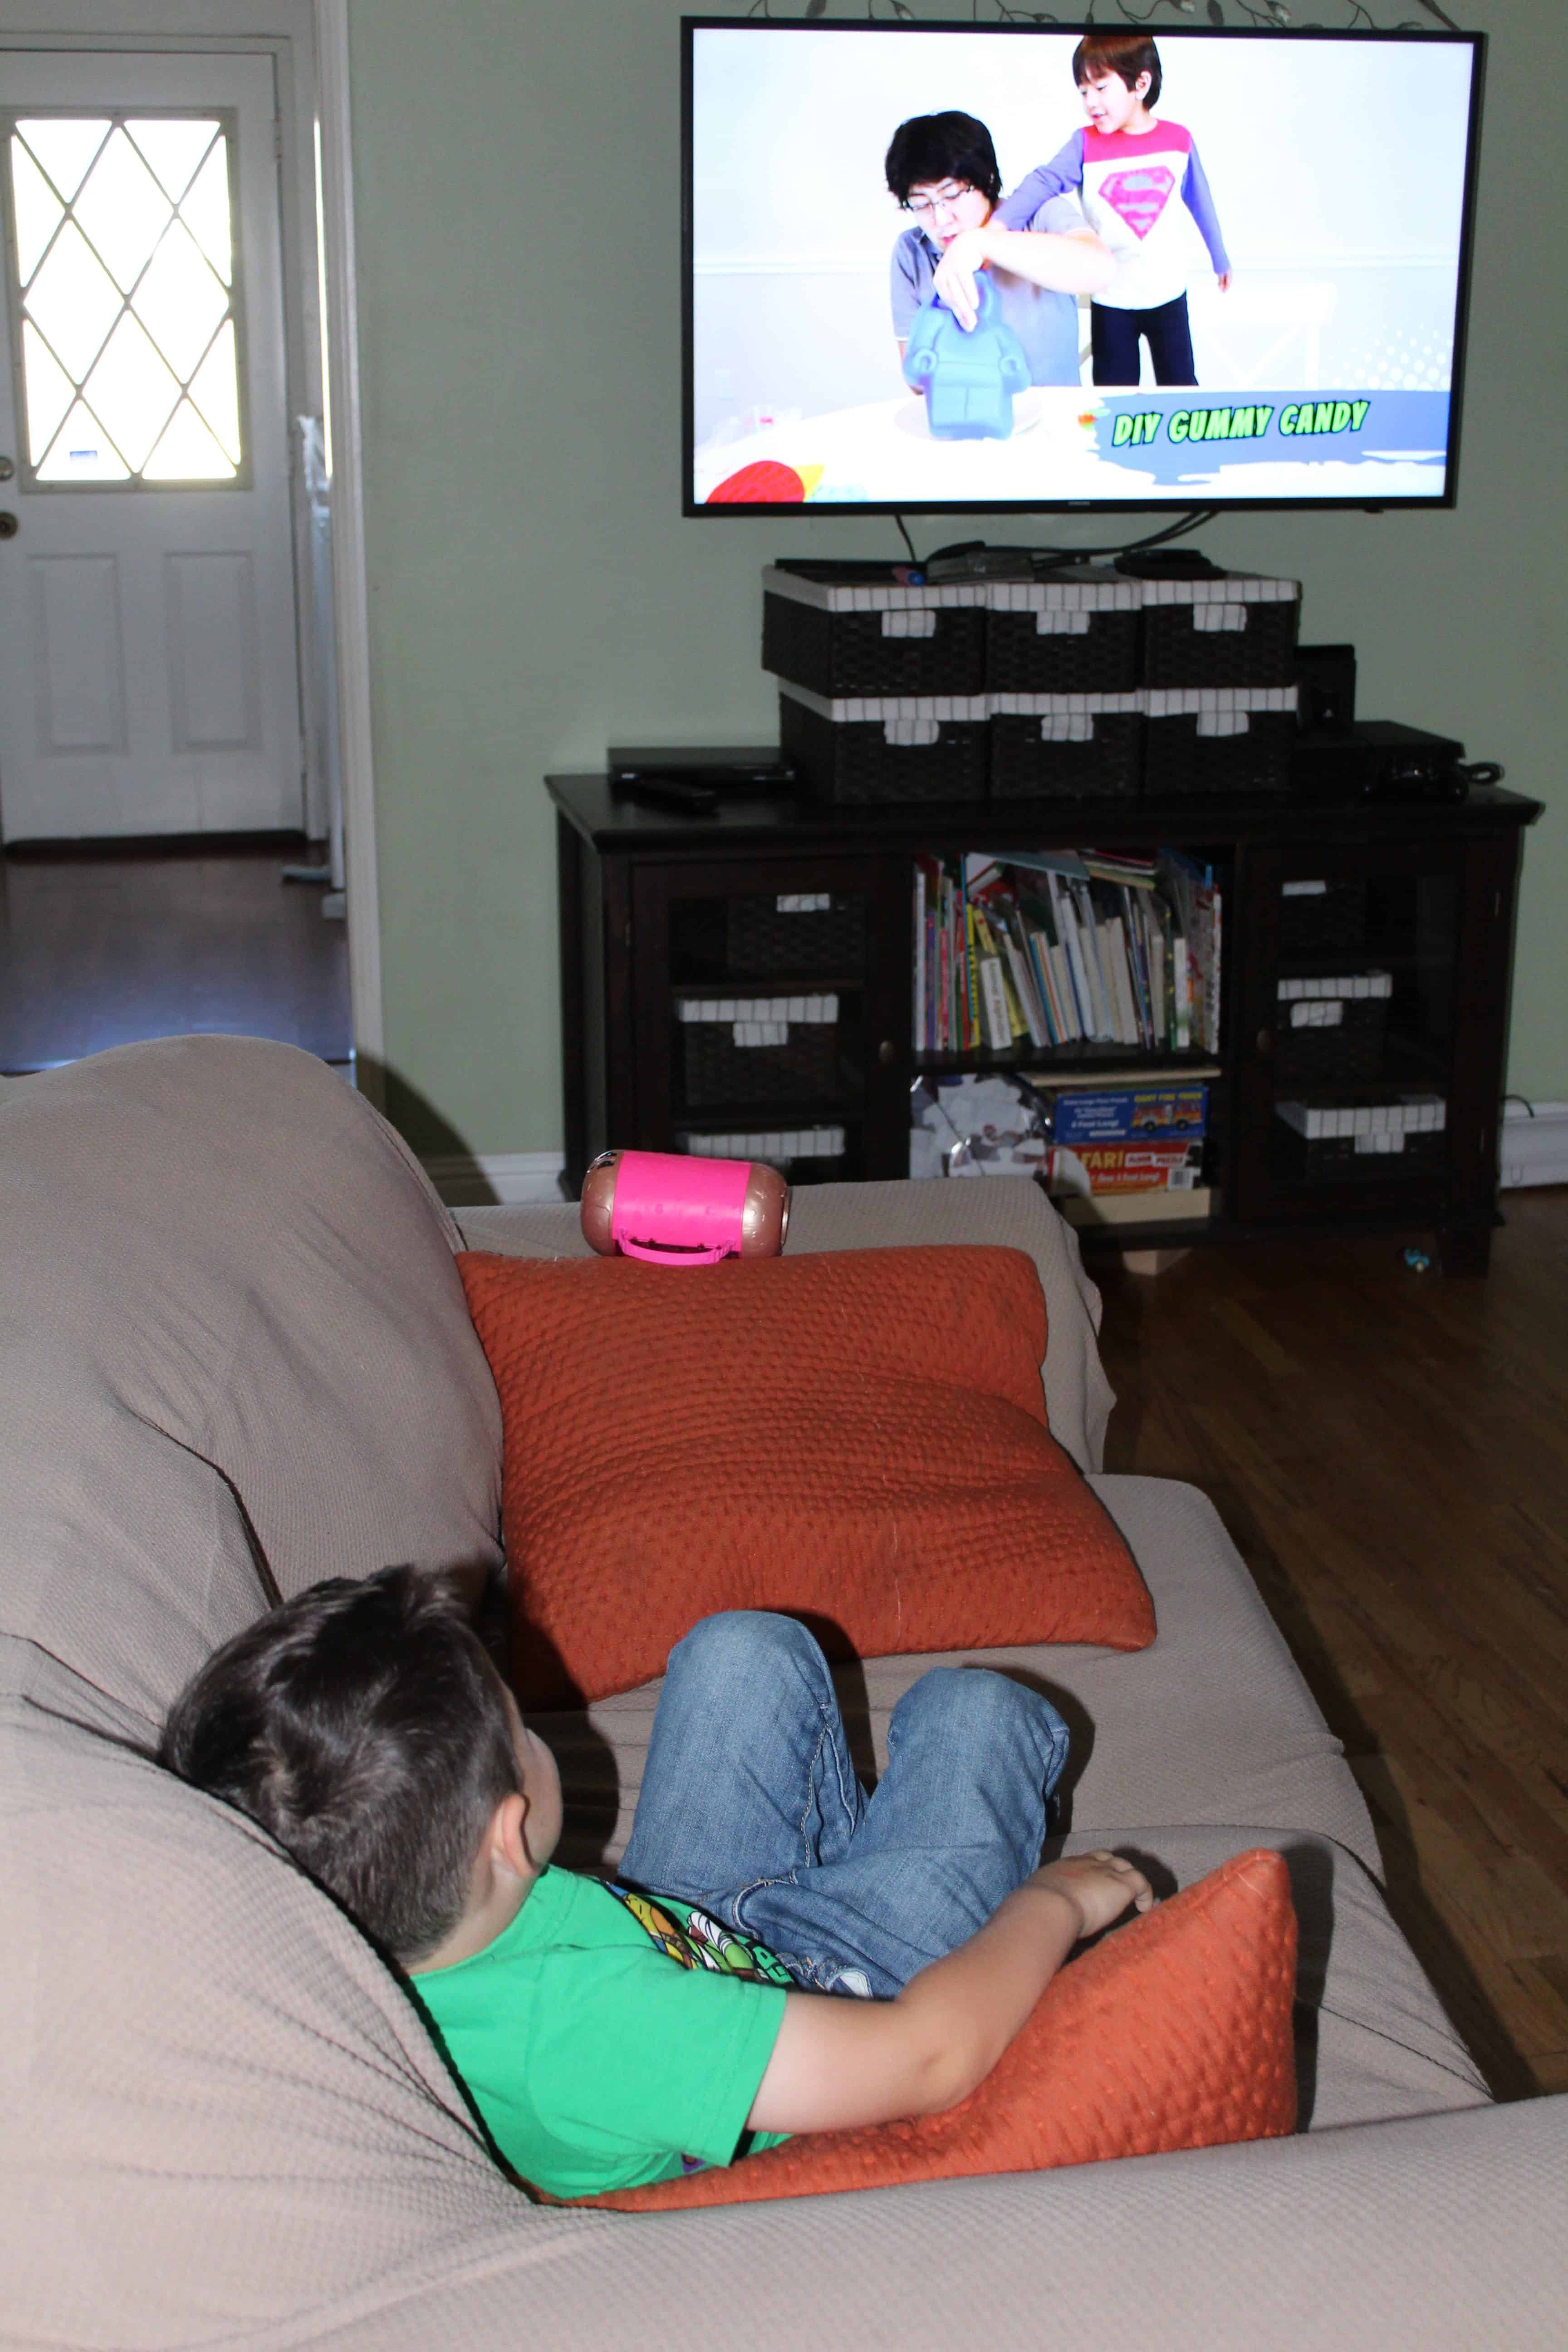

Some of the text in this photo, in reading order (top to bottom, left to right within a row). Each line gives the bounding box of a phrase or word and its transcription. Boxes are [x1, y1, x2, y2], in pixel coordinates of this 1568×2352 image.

[1112, 399, 1371, 447] DIY GUMMY CANDY
